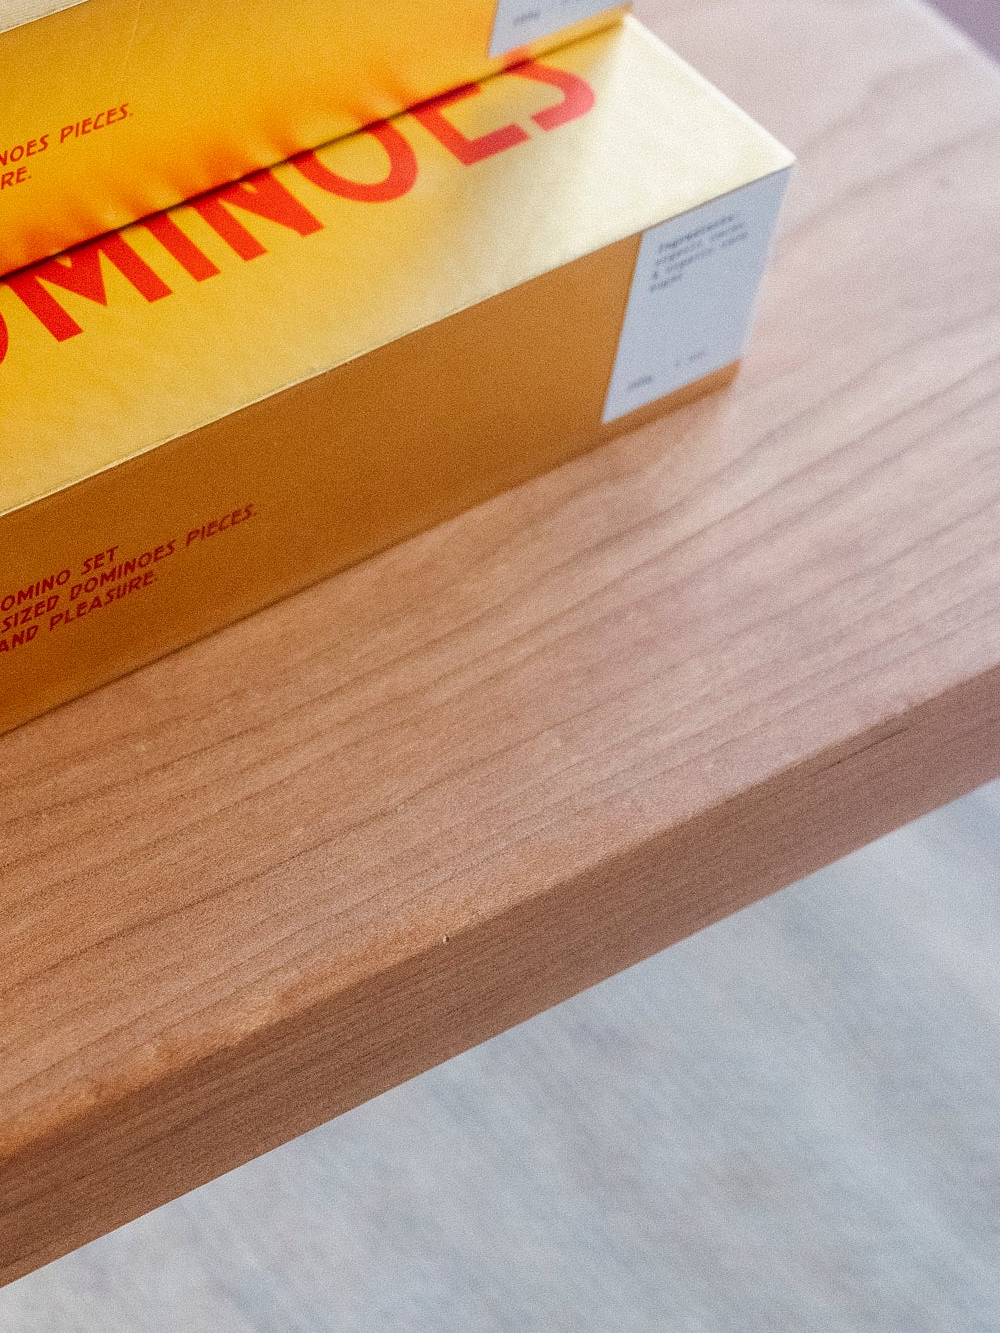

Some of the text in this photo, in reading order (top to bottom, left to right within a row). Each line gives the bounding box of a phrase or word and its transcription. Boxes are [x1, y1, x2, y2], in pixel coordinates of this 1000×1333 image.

[59, 103, 133, 144] PIECES.
[70, 539, 176, 602] DOMINOES
[185, 504, 258, 548] PIECES.
[81, 545, 119, 575] SET
[49, 570, 158, 632] PLEASURE.
